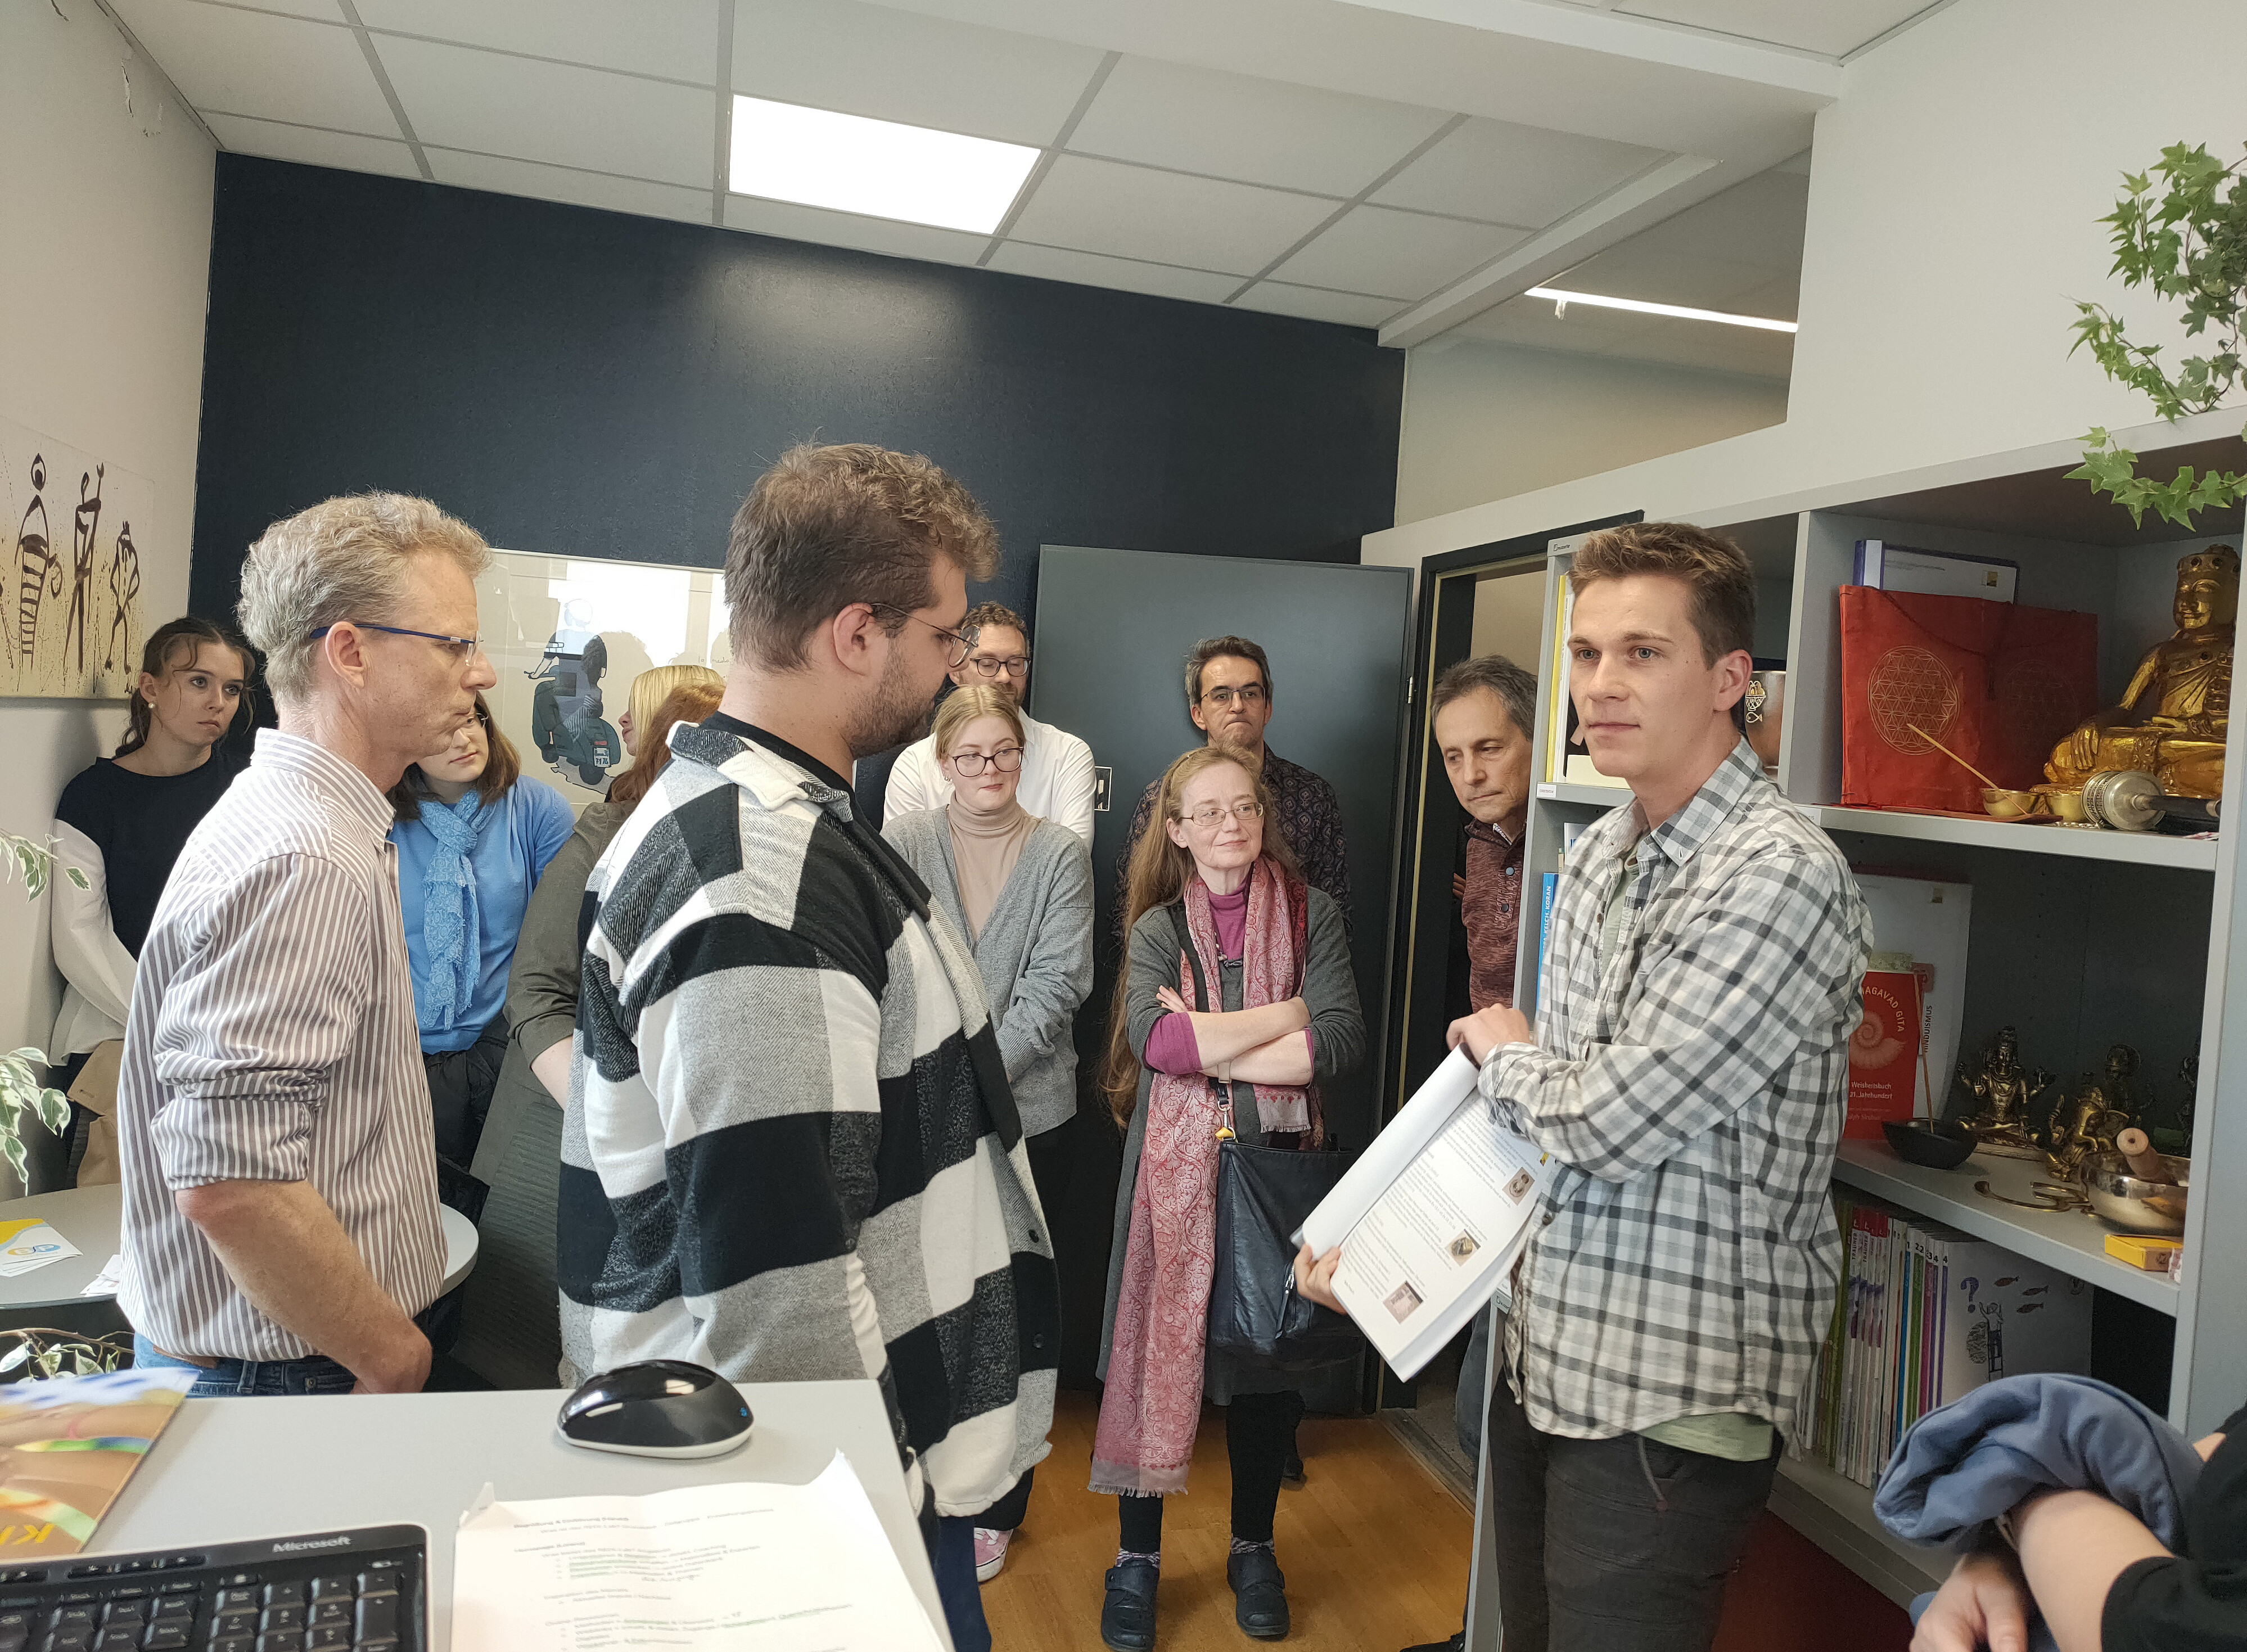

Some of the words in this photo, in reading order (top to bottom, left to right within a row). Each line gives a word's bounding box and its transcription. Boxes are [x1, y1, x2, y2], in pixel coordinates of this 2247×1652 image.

[1851, 1081, 1892, 1090] Weisheitsbuch
[1858, 1091, 1894, 1100] Jahrhundert
[272, 1536, 351, 1553] Microsoft
